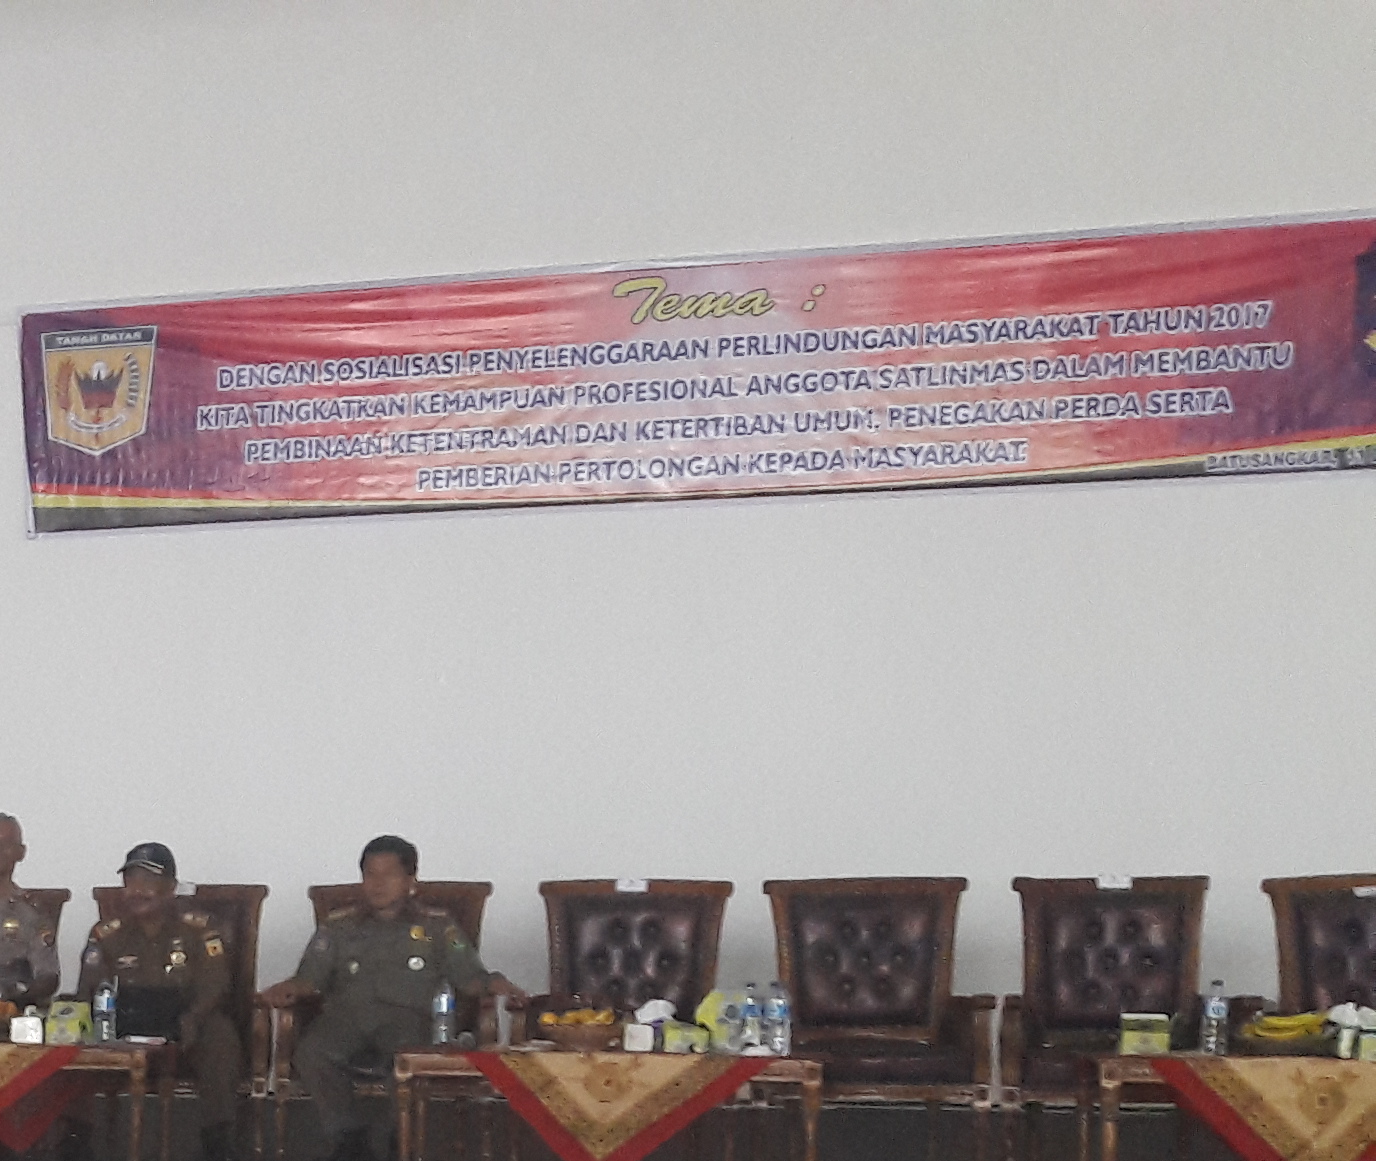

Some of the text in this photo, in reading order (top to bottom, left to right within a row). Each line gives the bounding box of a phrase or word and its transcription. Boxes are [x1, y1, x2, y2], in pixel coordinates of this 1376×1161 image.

[612, 276, 776, 325] Tema
[218, 301, 1272, 390] DENGAN SOSIALISASI PENYELENGGARAAN PERLINDUNGAN MASYARAKAT TAHUN 2017
[197, 341, 1293, 430] KITA TINGKATKAN KEMAMPUAN PROFESIONAL ANGGOTA SATLINMAS DALAM MEMBANTU
[245, 435, 384, 464] PEMBINAAN
[389, 424, 568, 456] KETENTRAMAN
[576, 420, 628, 445] DAN
[635, 413, 786, 442] KETERTIBAN
[887, 398, 1046, 429] PENEGAKAN
[1053, 393, 1140, 419] PERDA
[1146, 388, 1232, 416] SERTA
[417, 438, 1028, 492] PEMBERIAN PERTOLONGAN KEPADA MASYARAKAT
